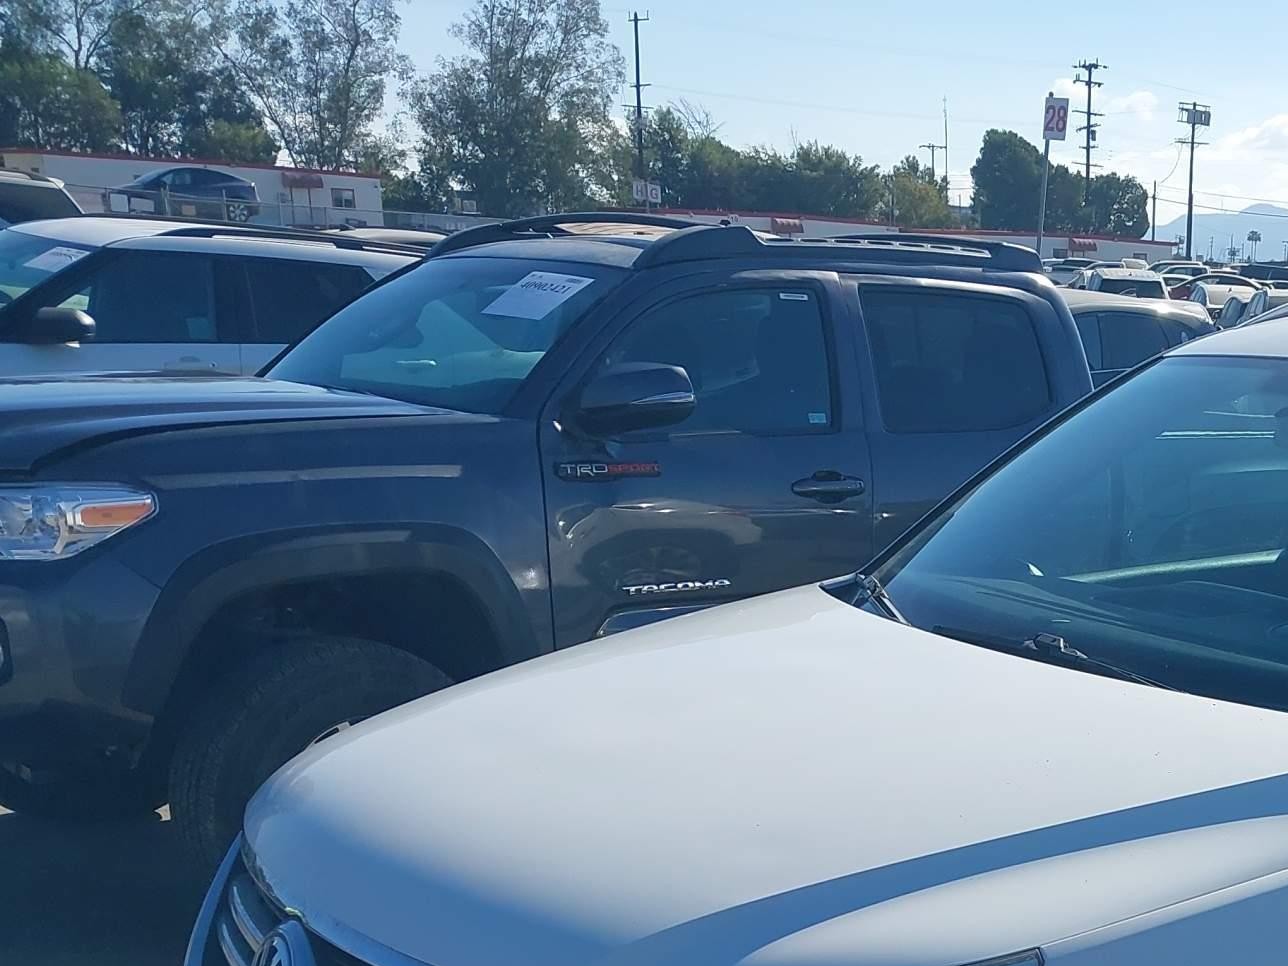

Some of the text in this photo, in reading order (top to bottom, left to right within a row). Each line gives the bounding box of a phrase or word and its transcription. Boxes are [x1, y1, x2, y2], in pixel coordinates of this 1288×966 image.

[1045, 104, 1067, 132] 28
[559, 463, 608, 477] TRD
[621, 578, 732, 596] TACOMA
